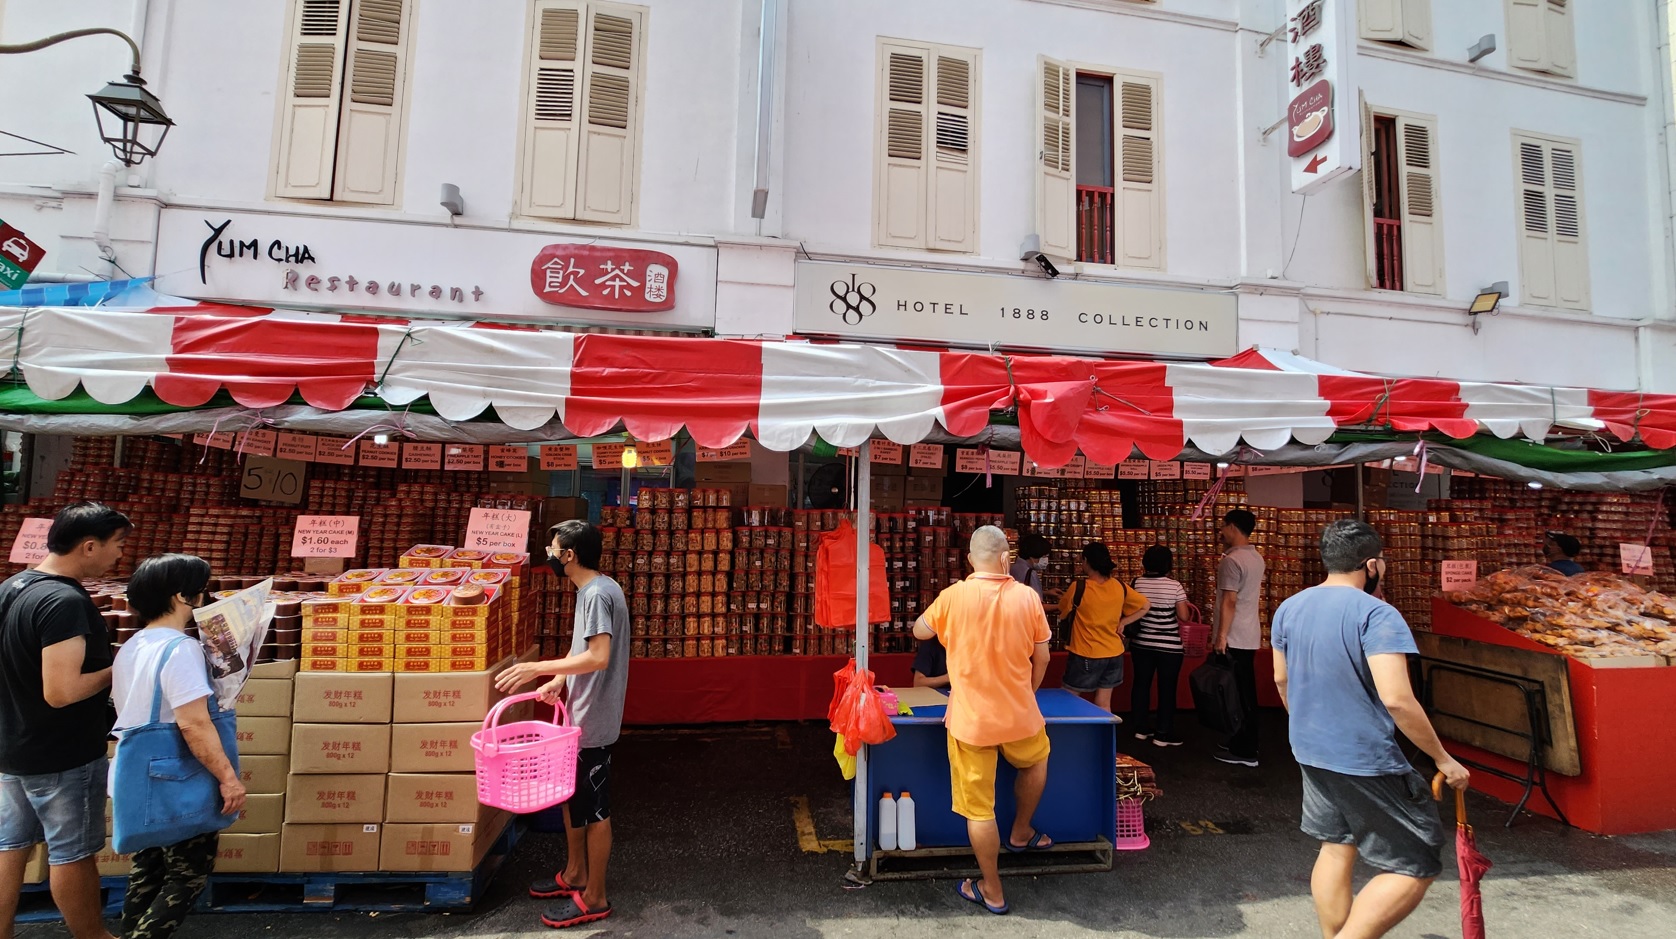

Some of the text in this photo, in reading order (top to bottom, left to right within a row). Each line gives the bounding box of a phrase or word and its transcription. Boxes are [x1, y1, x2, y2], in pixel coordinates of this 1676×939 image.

[268, 239, 316, 264] CHA
[0, 260, 20, 280] axi
[542, 258, 641, 299] 飲茶
[282, 268, 484, 303] Restaurant
[647, 270, 665, 300] 酒楼
[897, 300, 1208, 332] HOTEL 1888 COLLECTION
[23, 541, 48, 550] $0.8
[301, 536, 329, 545] $1.60
[476, 537, 488, 546] $5
[324, 690, 363, 700] 发财年糕
[423, 690, 462, 700] 发财年糕
[428, 700, 442, 708] 800g
[321, 741, 362, 751] 发财年糕
[420, 740, 458, 750] 发财年糕
[326, 752, 342, 760] 800g
[425, 750, 439, 758] 800g
[317, 790, 357, 801] 发财年糕
[415, 790, 454, 801] 发财年糕
